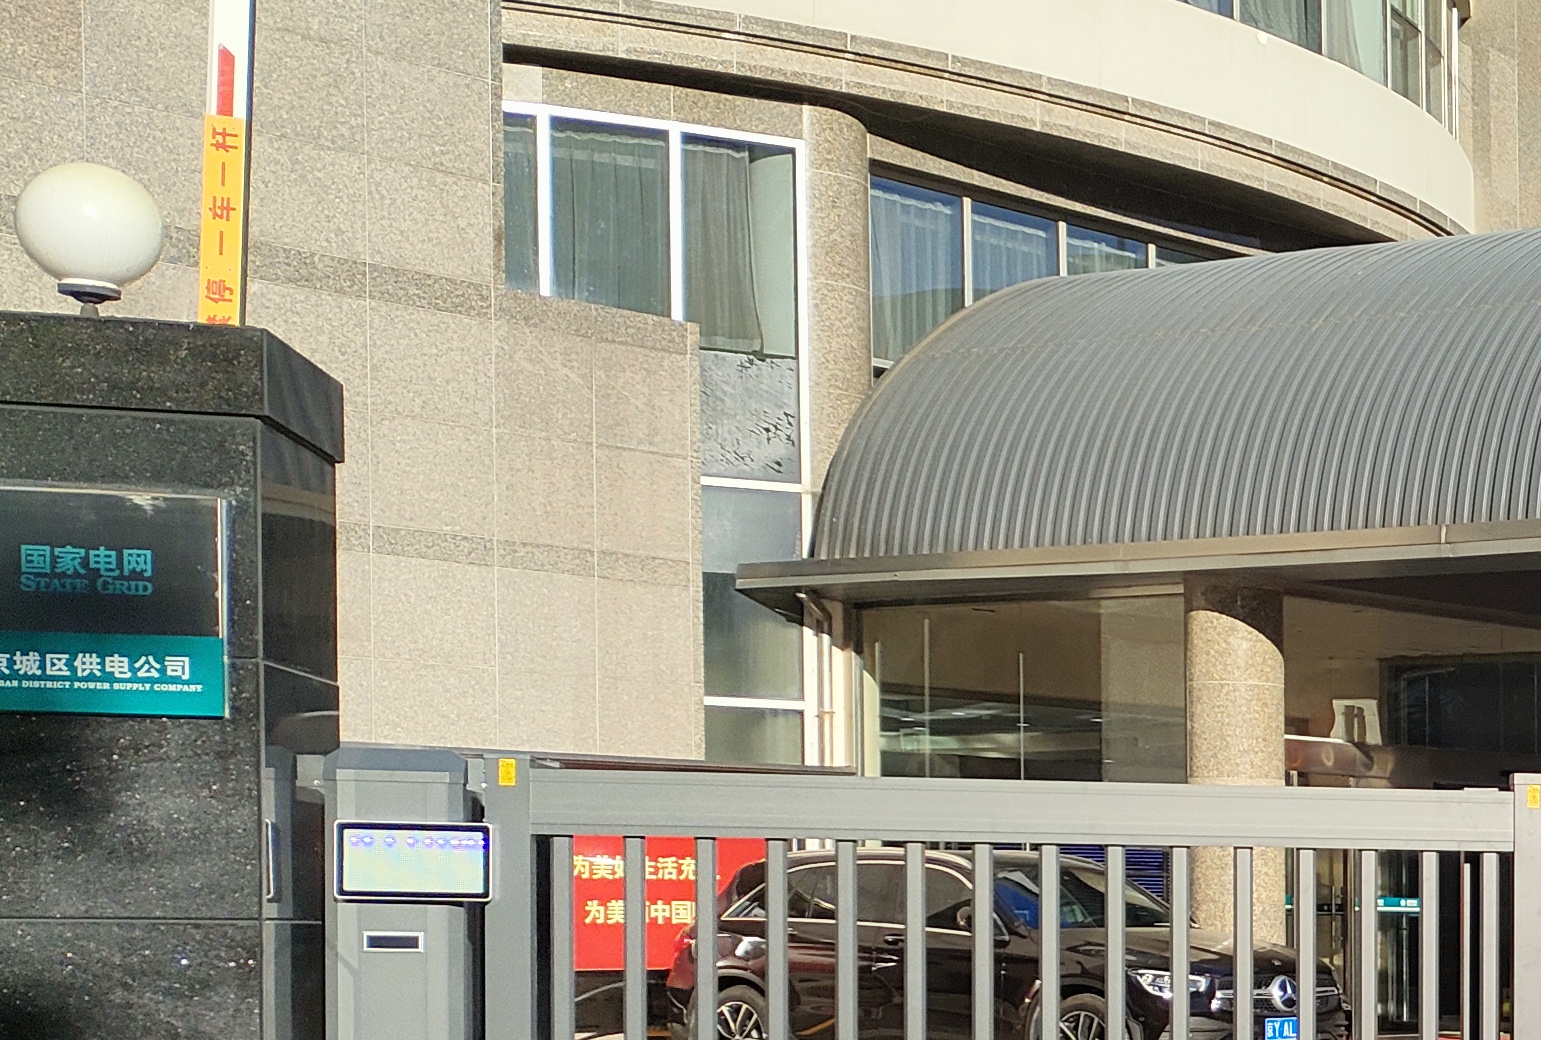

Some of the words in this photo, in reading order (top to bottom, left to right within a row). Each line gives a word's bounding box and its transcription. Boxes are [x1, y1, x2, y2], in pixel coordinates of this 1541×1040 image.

[20, 544, 153, 577] 国家电网
[20, 574, 88, 593] STATE
[97, 576, 154, 595] GRID
[22, 680, 71, 689] DISTRICT
[74, 681, 111, 690] POWER
[113, 682, 151, 691] SUPPLY
[153, 683, 203, 692] COMPANY
